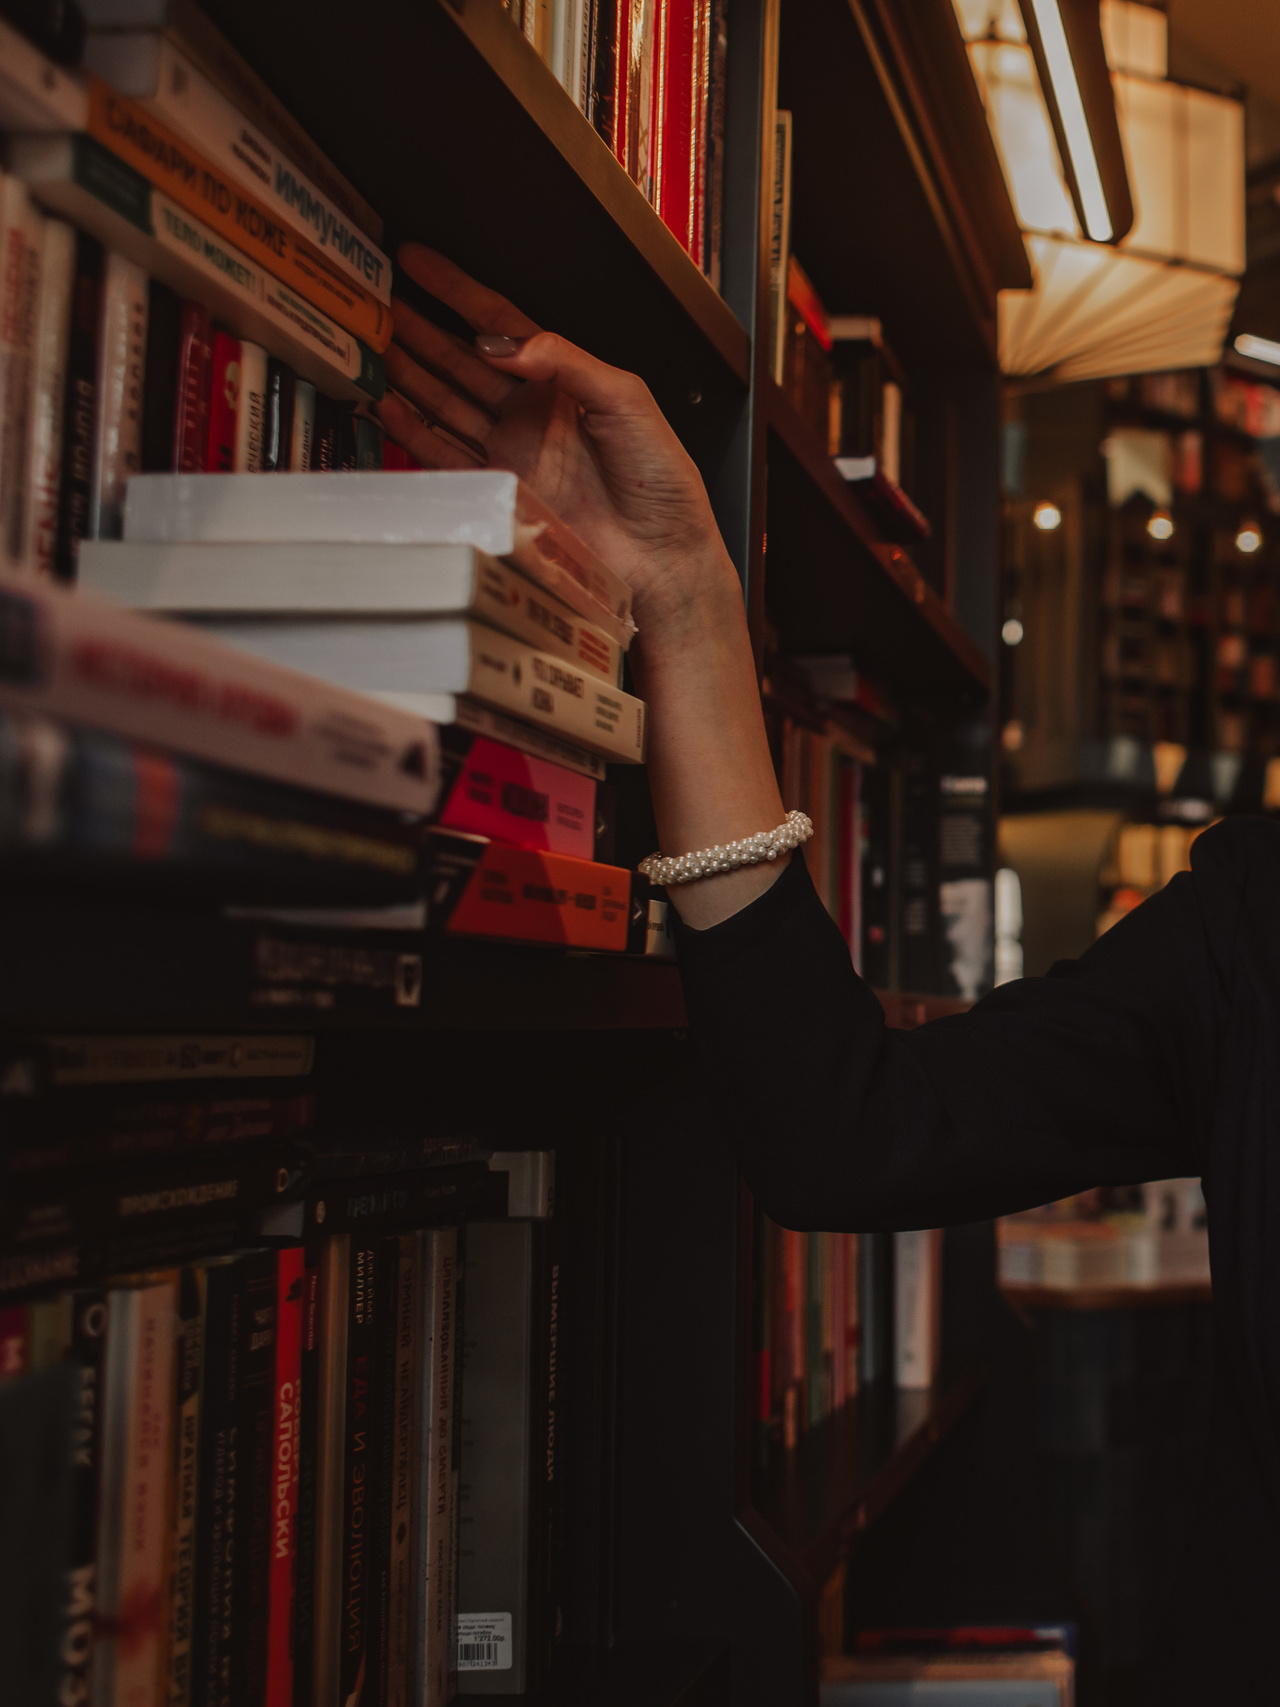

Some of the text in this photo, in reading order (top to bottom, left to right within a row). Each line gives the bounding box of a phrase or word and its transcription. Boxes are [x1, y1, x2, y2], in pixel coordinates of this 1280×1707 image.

[106, 98, 197, 190] САФАРИ
[203, 169, 231, 214] ПО
[236, 194, 287, 258] КОЖЕ
[164, 207, 201, 252] ТЕЛО
[275, 162, 385, 288] ИММУНИТЕТ
[307, 1302, 316, 1351] Scientist
[355, 1251, 365, 1325] МИЛЛЕР
[367, 1249, 378, 1327] ДЖЕЙМС
[546, 1264, 560, 1482] ВЫМЕРШИЕ ЛЮДИ
[275, 1380, 294, 1560] САПОЛЬСКИ
[396, 1267, 413, 1510] УМНЫЙ НЕАНДЕРТАЛЕЦ
[437, 1256, 453, 1515] ЦИВИЛИЗОВАННЫЙ ДО СМЕРТИ
[299, 1445, 314, 1645] ЭВОЛЮЦИЯ
[346, 1355, 369, 1653] ЕДА И ЭВОЛЮЦИЯ
